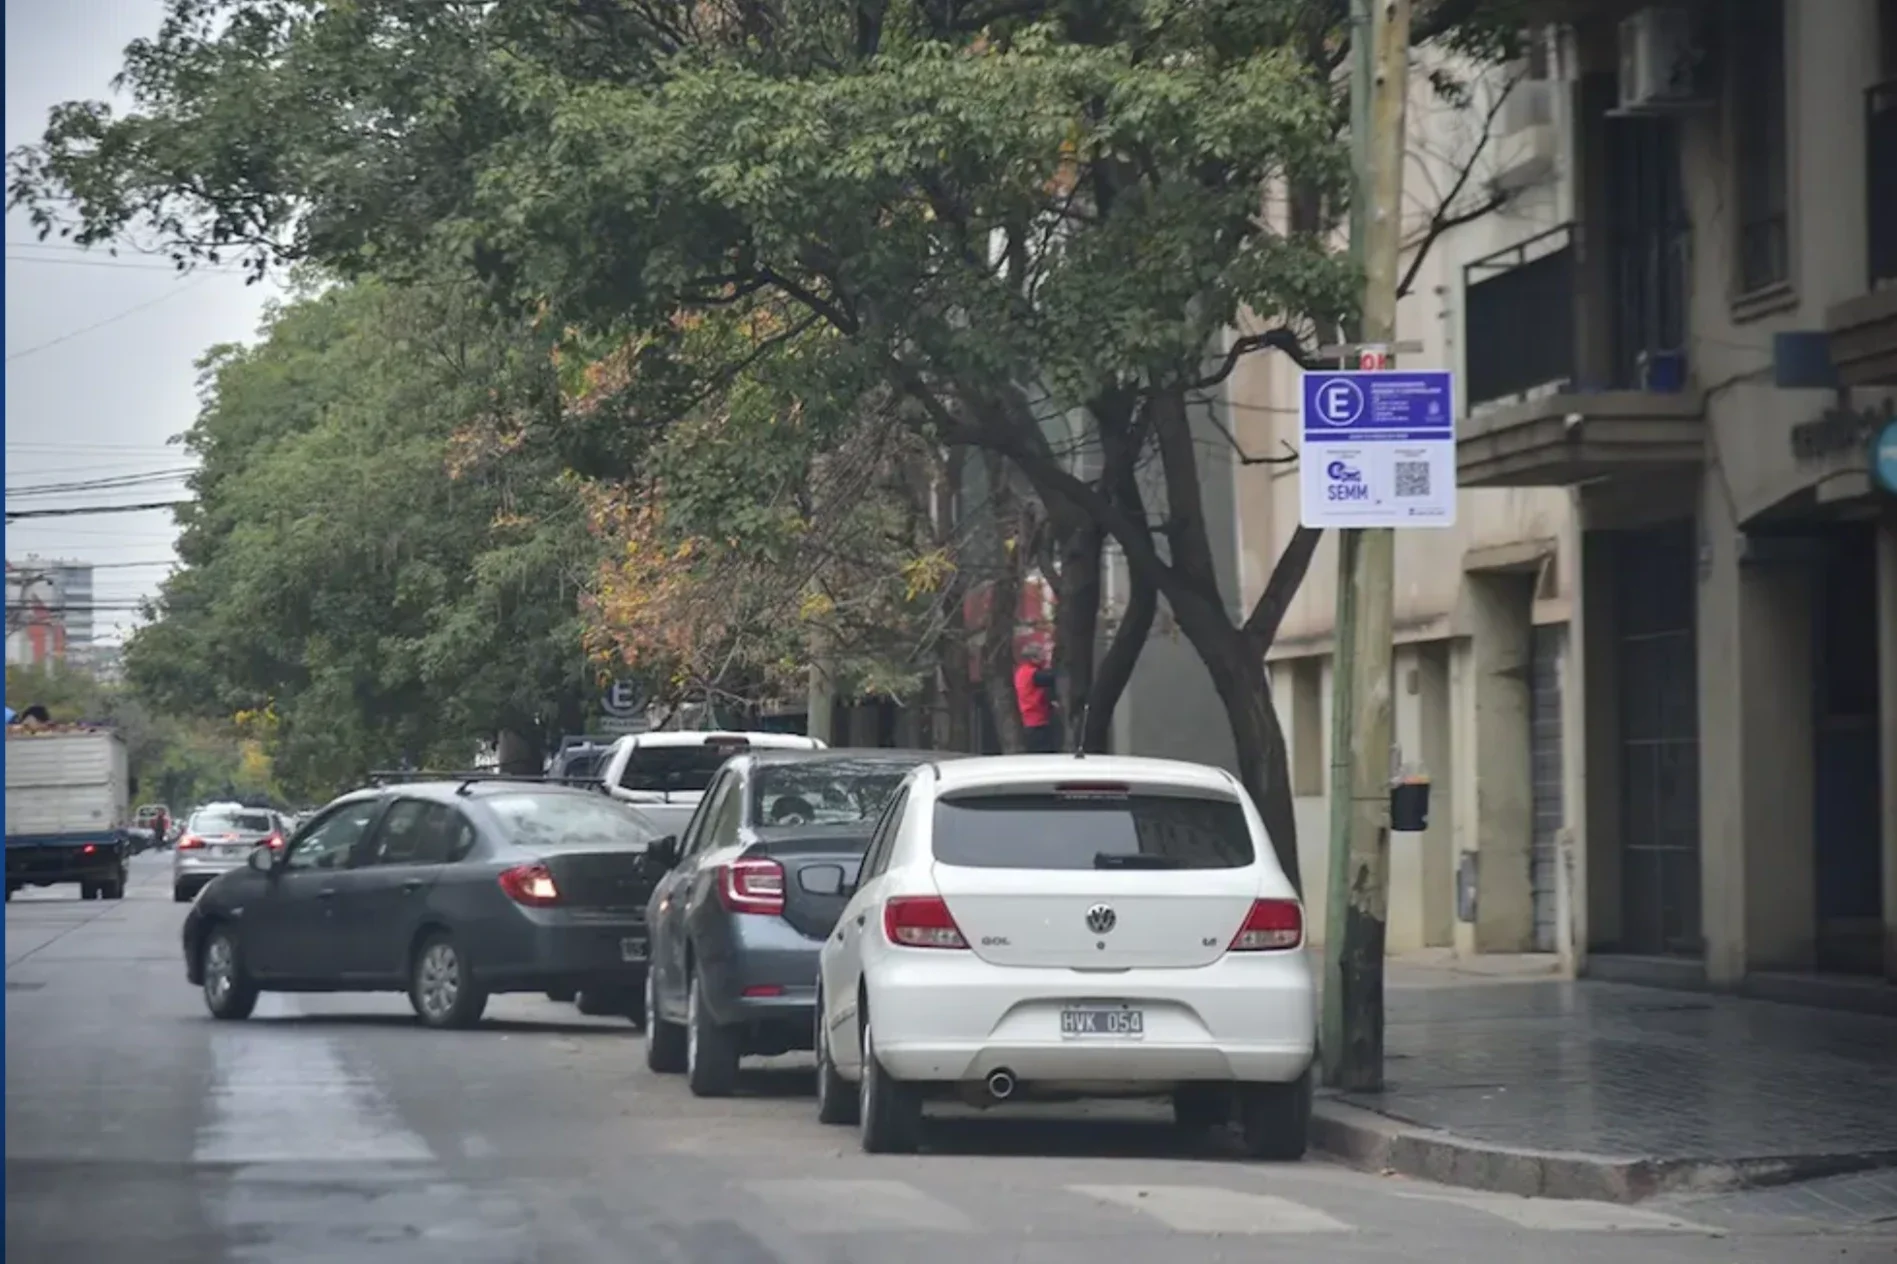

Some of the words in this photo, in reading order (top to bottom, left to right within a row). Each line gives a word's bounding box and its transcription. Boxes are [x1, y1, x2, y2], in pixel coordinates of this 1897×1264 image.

[1328, 387, 1350, 418] E
[1328, 484, 1368, 501] SEMM
[612, 679, 633, 707] E
[1064, 1012, 1096, 1031] HVK
[1107, 1012, 1140, 1031] 054
